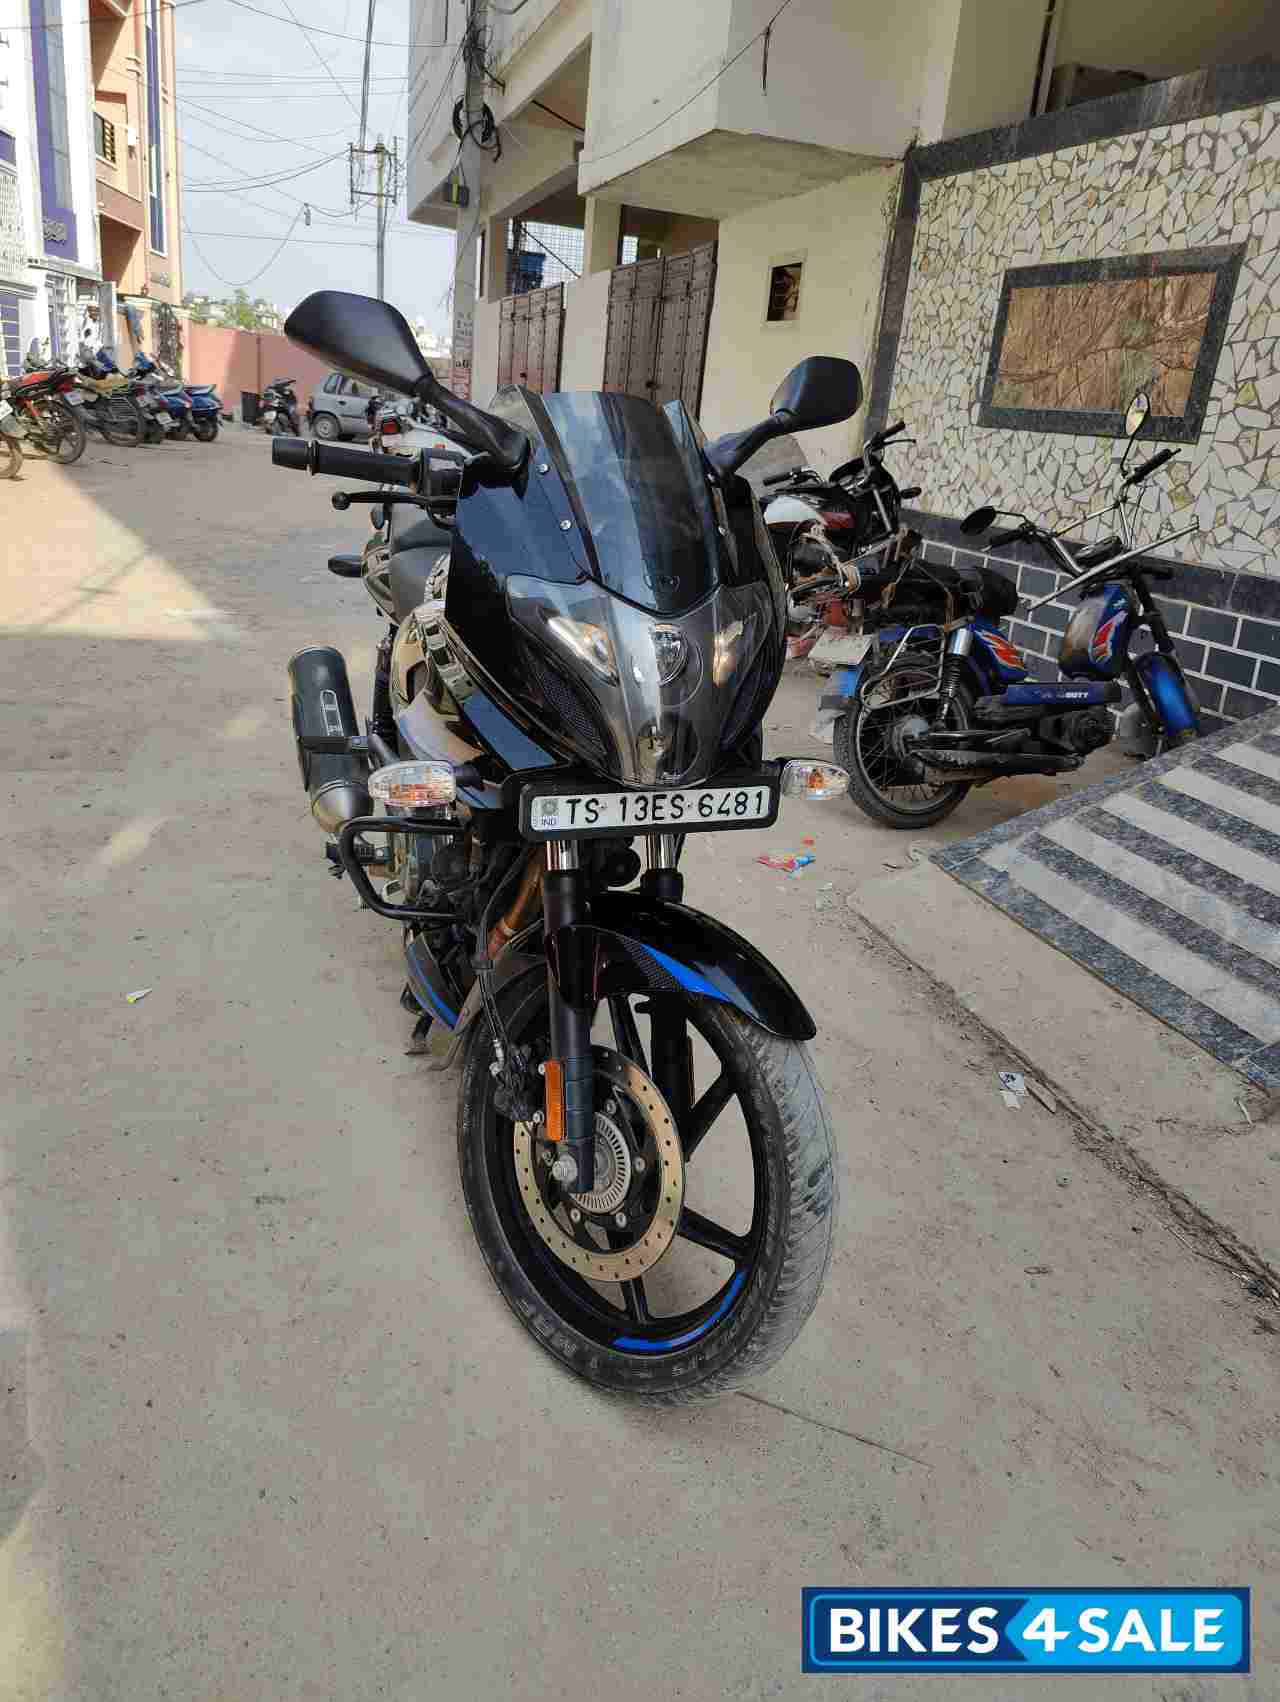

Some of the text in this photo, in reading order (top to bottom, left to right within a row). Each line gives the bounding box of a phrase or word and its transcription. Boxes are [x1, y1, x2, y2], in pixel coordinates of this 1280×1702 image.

[565, 790, 763, 825] TS 13ES 6481
